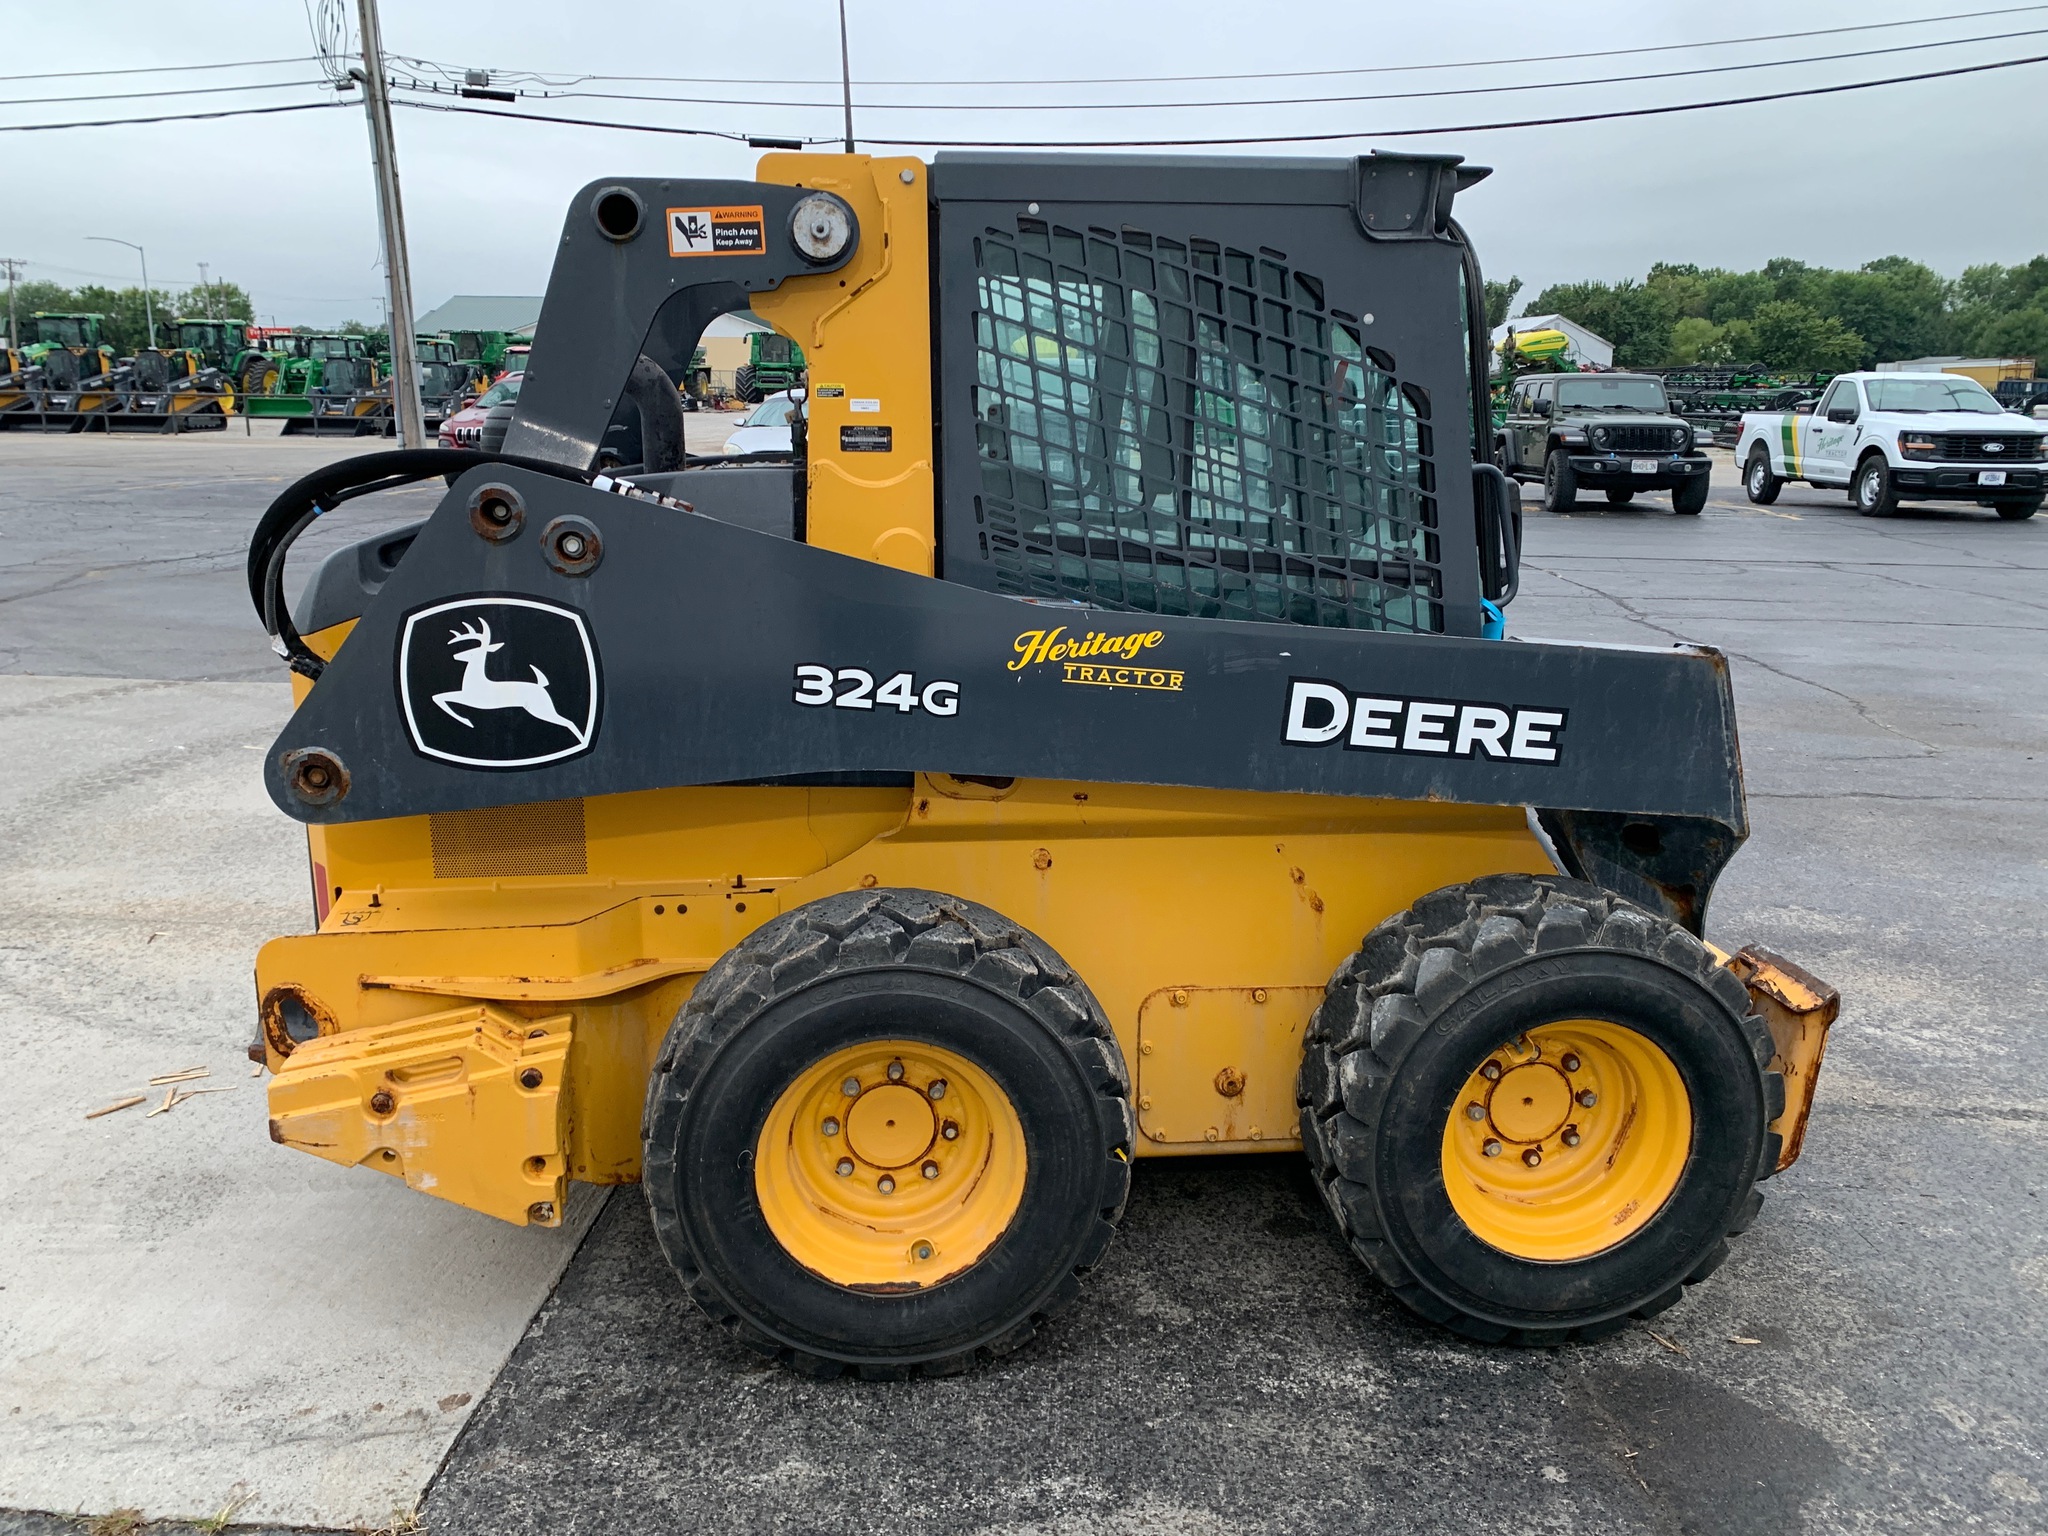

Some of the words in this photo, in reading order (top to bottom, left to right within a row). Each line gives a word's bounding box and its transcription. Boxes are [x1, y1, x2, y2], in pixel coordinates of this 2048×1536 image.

[715, 228, 737, 236] Pinch
[740, 227, 758, 236] Area
[716, 239, 733, 247] Keep
[734, 238, 753, 247] Away
[1816, 435, 1844, 454] Heritage
[1007, 626, 1165, 671] Heritage
[794, 664, 960, 717] 324G
[1063, 664, 1184, 688] TRACTOR
[1285, 681, 1563, 761] DEERE
[807, 972, 969, 1005] GALAXY
[1434, 959, 1570, 1036] GALAXY
